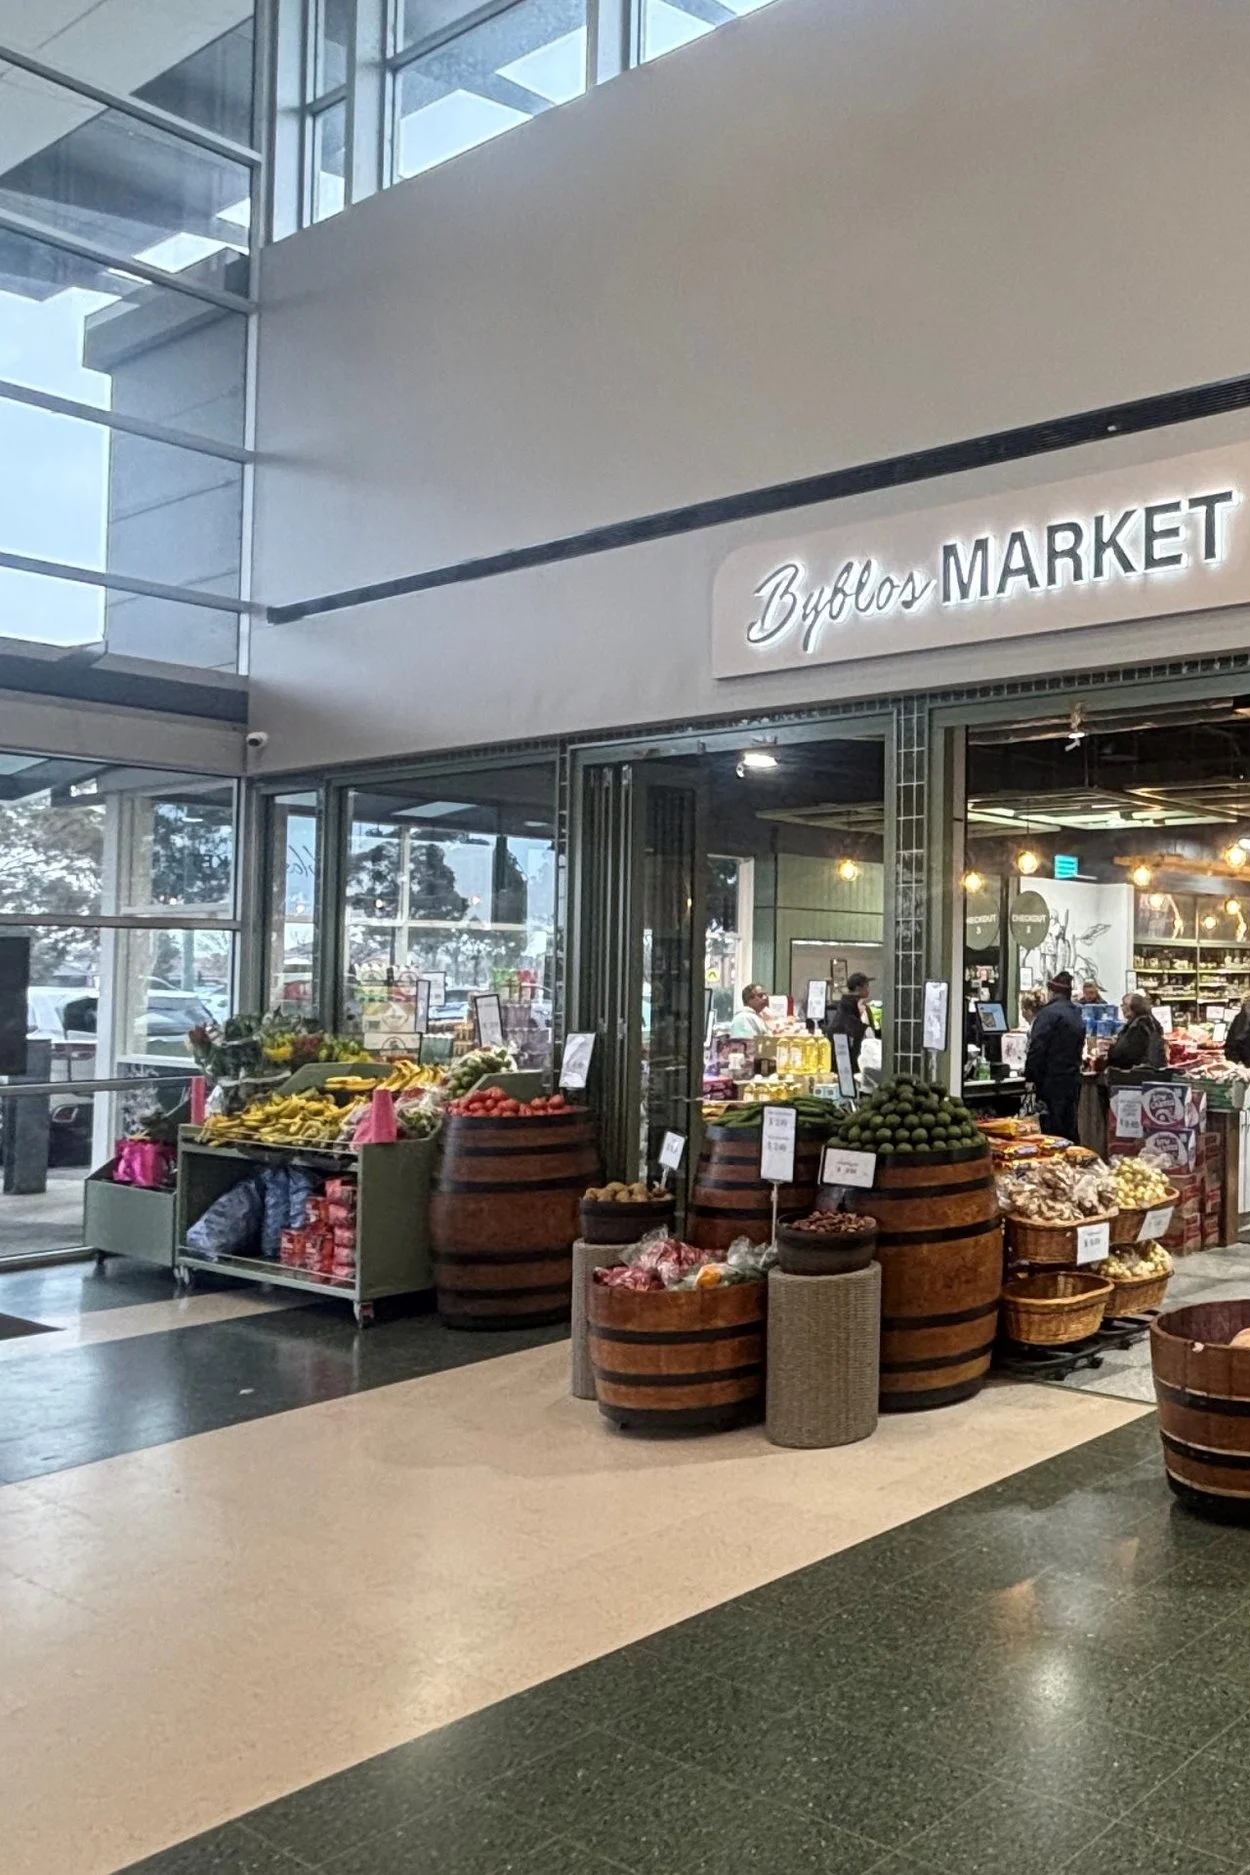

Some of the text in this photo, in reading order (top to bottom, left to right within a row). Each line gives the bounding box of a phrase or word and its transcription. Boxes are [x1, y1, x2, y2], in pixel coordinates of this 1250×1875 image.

[747, 490, 1233, 653] Byblos MARKET
[1011, 914, 1046, 923] CHECKOUT
